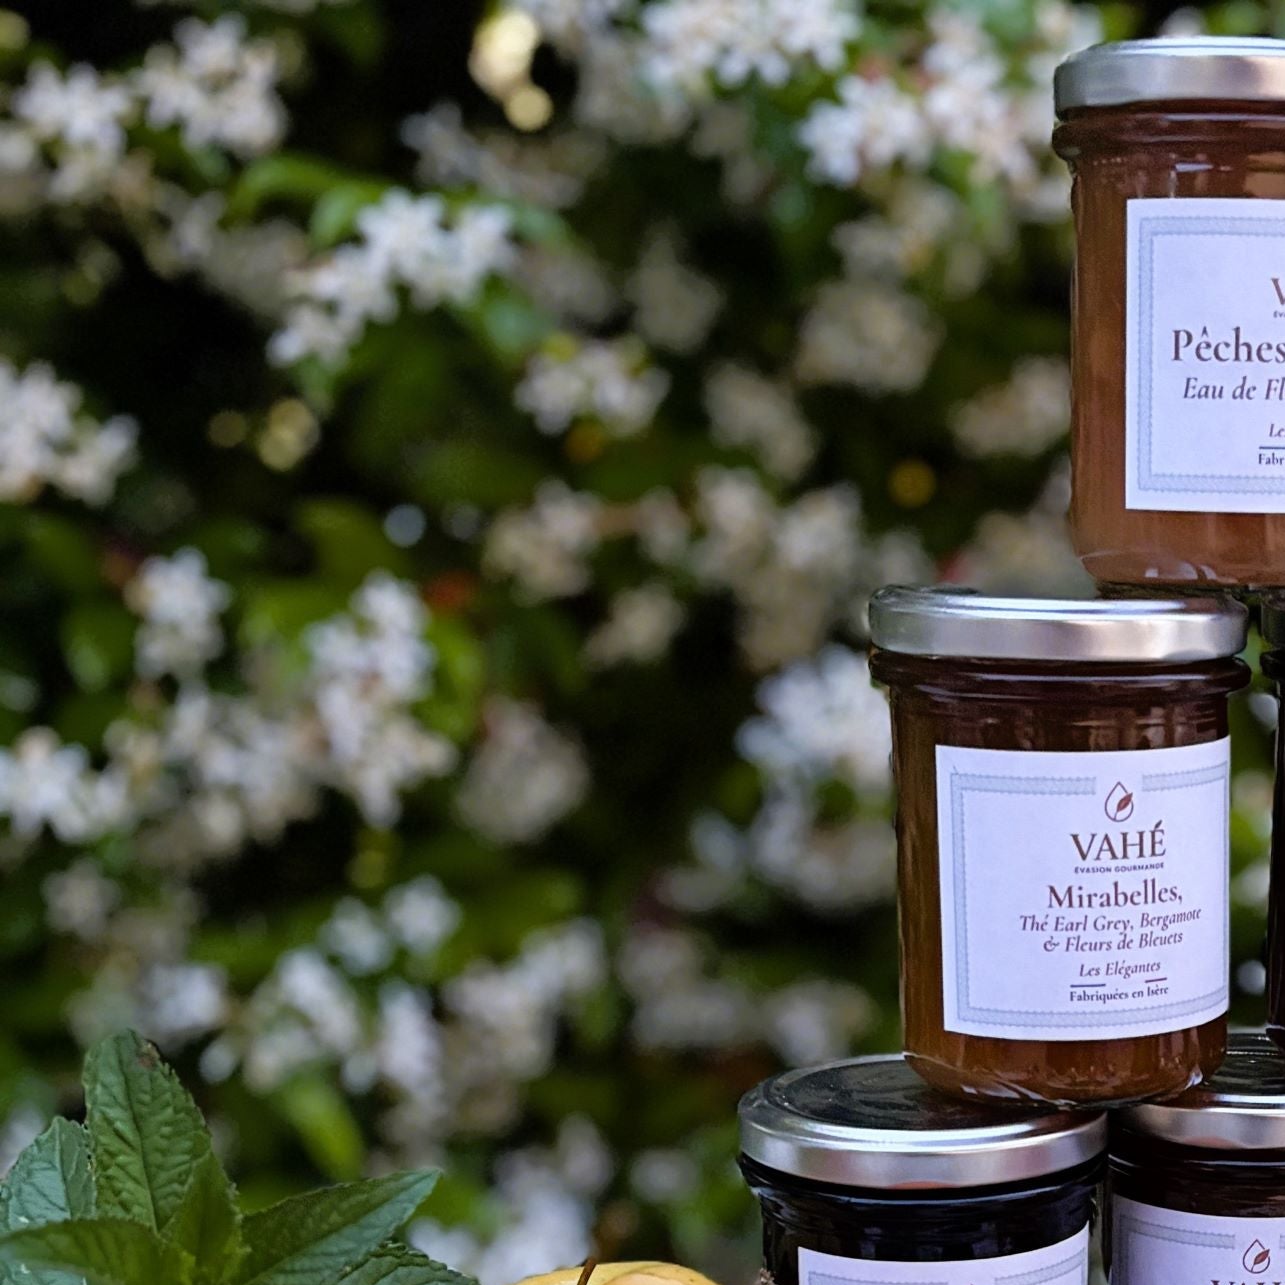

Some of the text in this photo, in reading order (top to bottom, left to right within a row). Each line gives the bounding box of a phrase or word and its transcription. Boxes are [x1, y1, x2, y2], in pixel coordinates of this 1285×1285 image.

[1183, 377, 1224, 400] Eau
[1232, 376, 1257, 400] de
[1070, 820, 1166, 861] VAHÉ
[1115, 863, 1164, 872] GOURMANDE
[1047, 879, 1183, 909] Mirabelles,
[1020, 909, 1201, 936] Thé Earl Grey, Bergamote
[1043, 931, 1183, 952] & Fleurs de Bleuets
[1079, 959, 1161, 979] Les Elégantes
[1070, 985, 1169, 1004] Fabriquées en Isère
